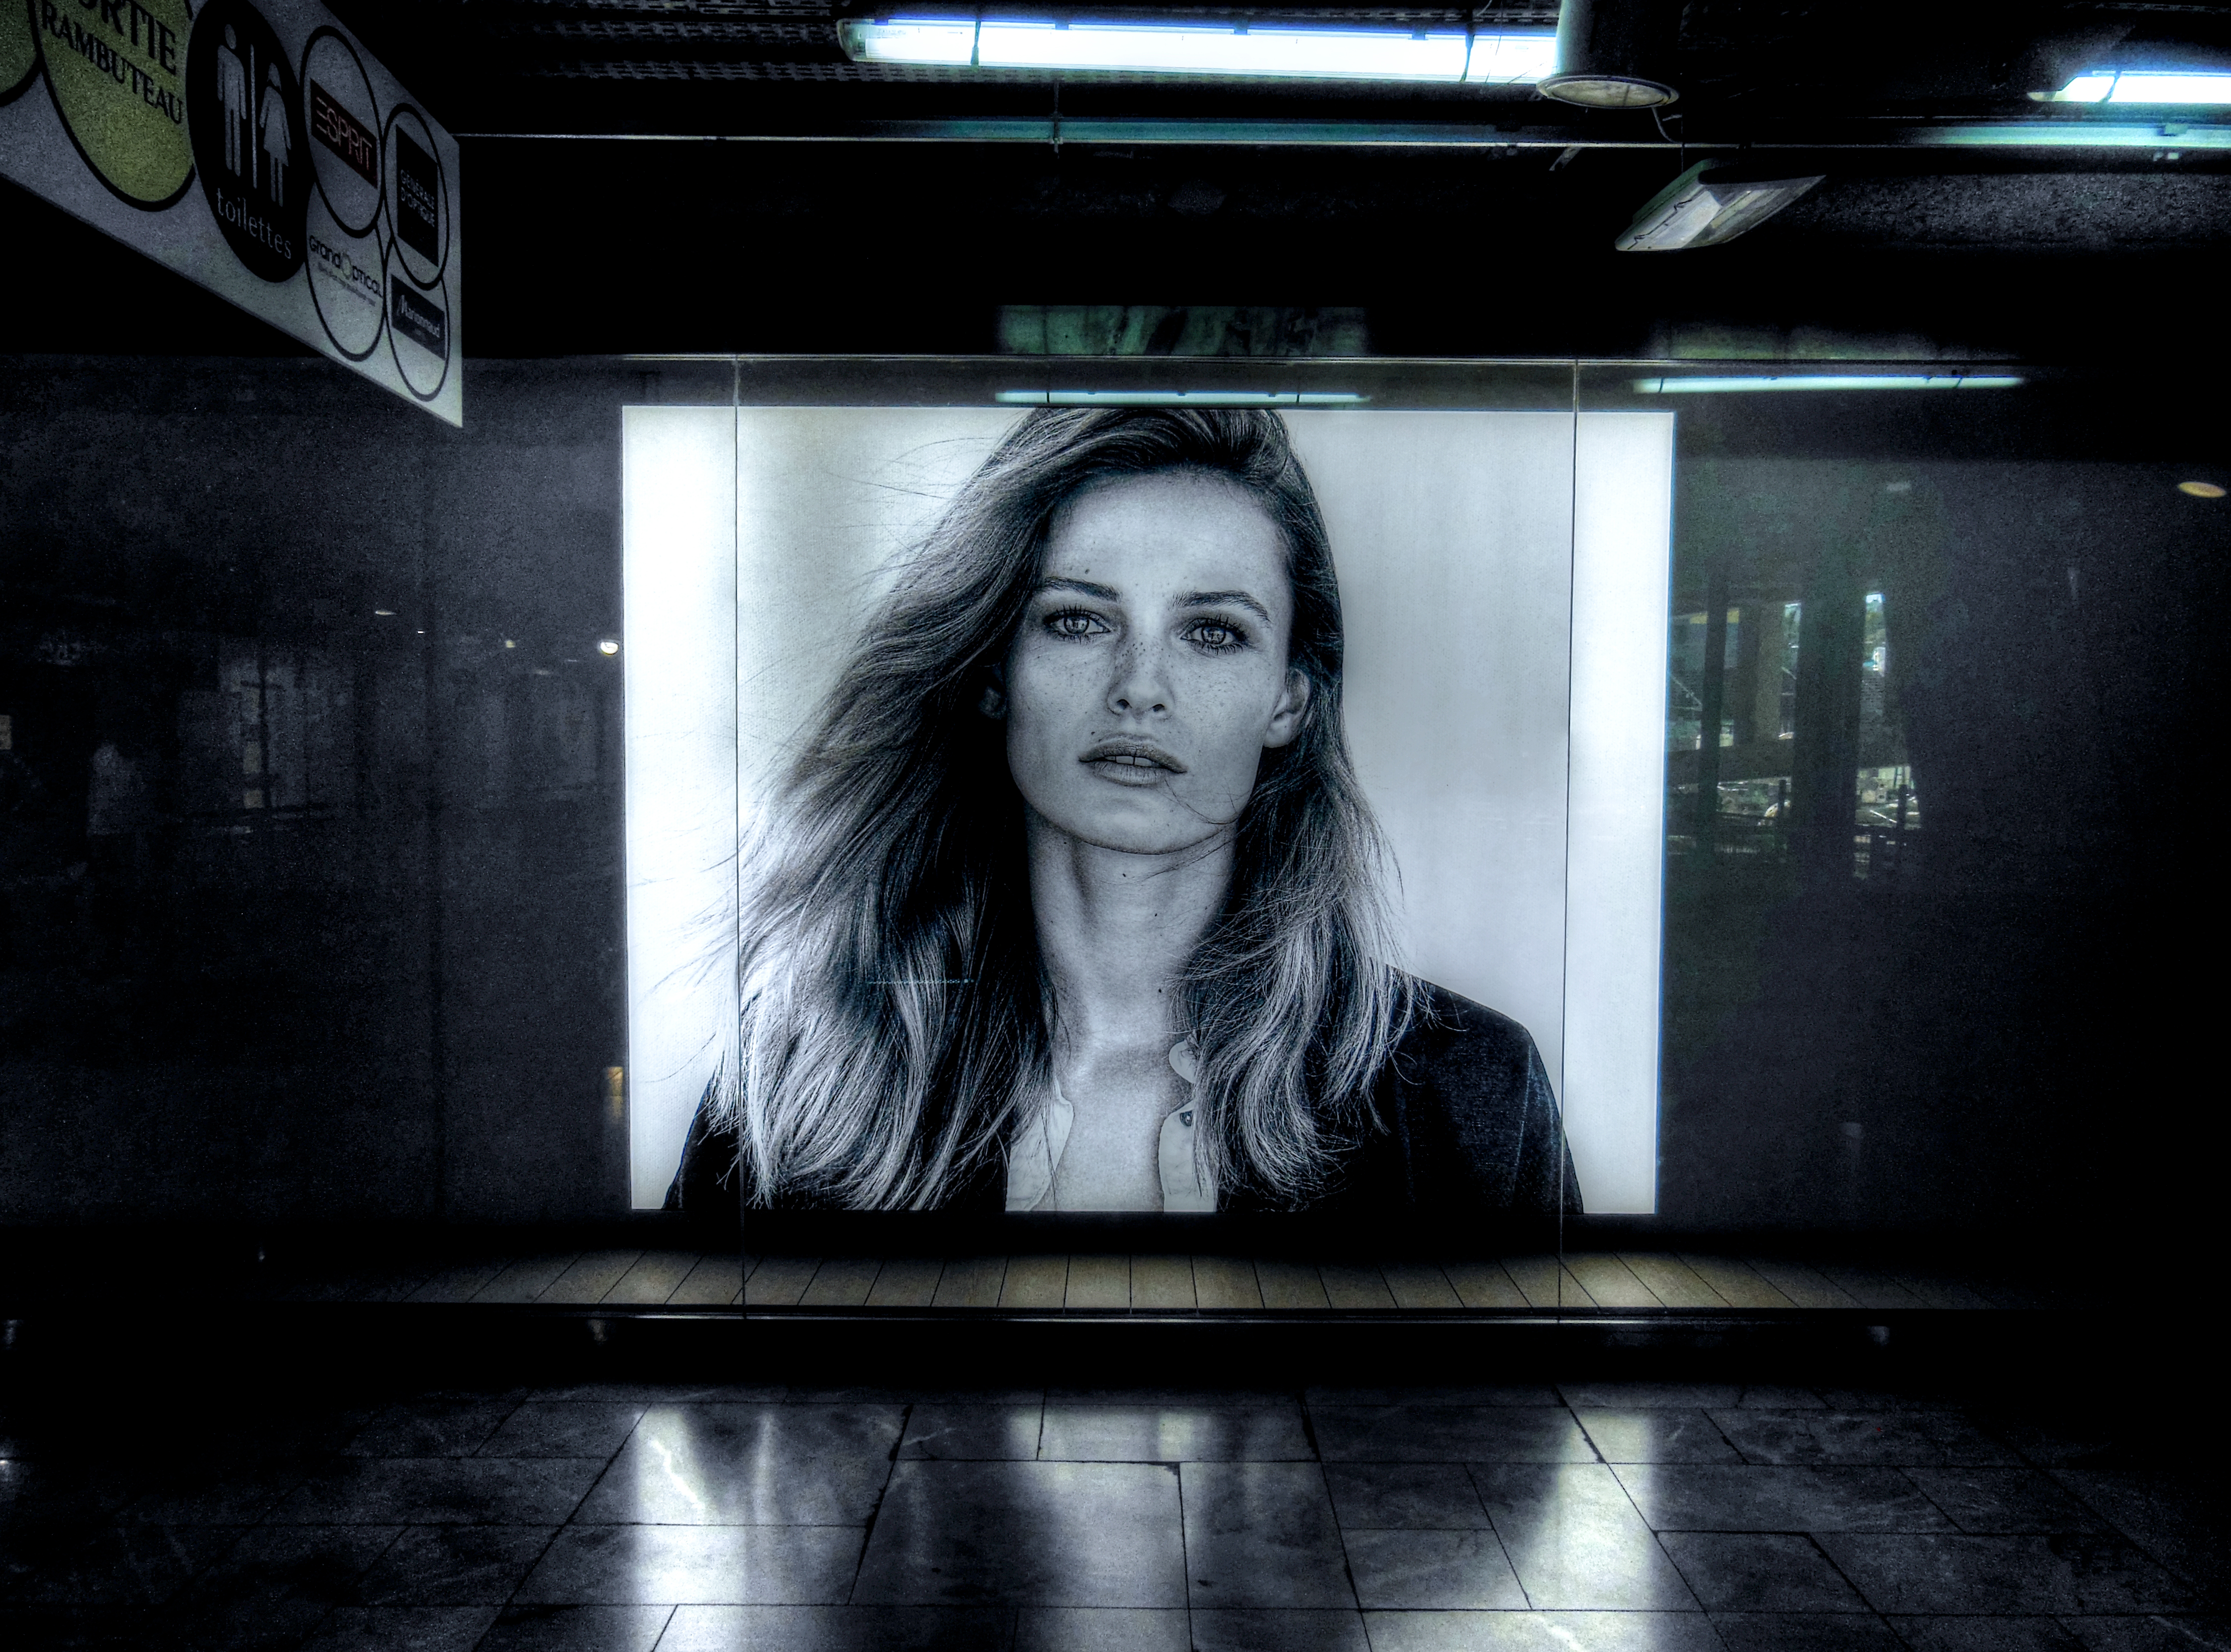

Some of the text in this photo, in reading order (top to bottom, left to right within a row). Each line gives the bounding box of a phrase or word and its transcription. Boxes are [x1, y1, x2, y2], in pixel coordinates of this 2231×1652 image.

[42, 0, 183, 124] RAMBUTEAU
[79, 0, 176, 76] RTIE
[316, 97, 373, 170] ESPRIT
[216, 188, 291, 259] toilettes
